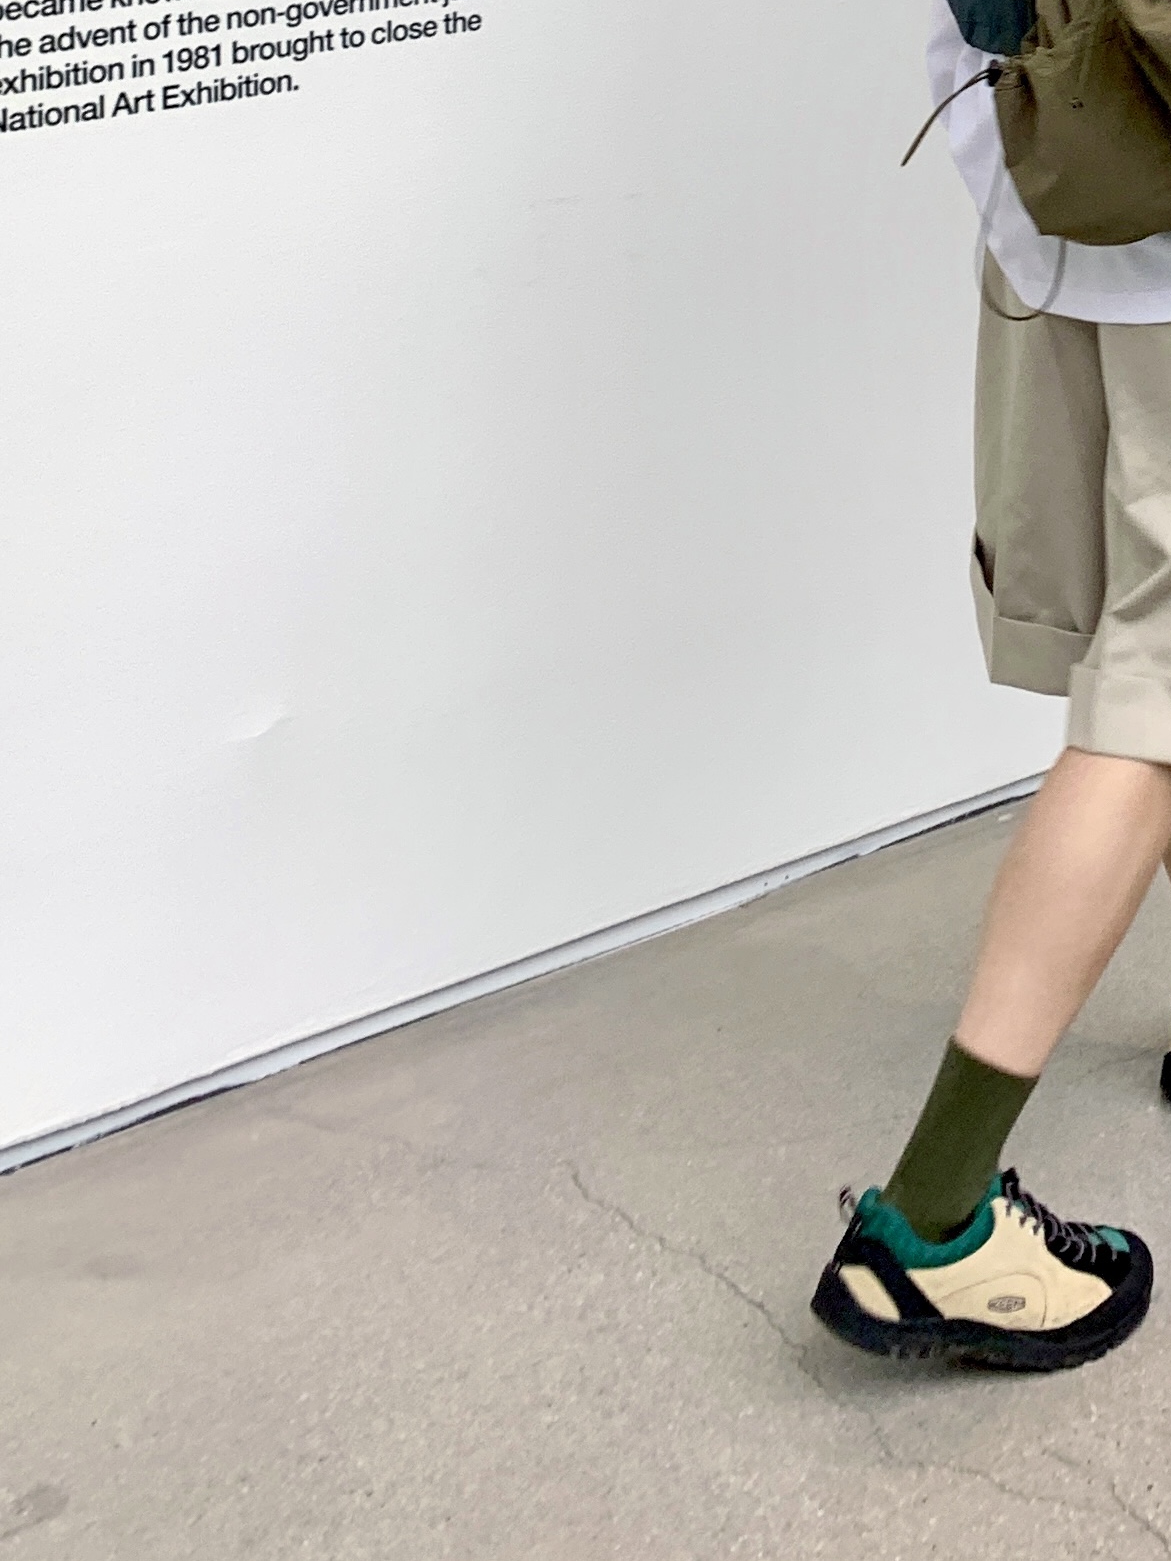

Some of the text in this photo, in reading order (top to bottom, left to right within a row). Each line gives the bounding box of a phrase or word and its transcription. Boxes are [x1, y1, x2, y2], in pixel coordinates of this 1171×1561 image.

[38, 18, 138, 55] advent
[142, 12, 173, 41] of
[175, 10, 222, 37] the
[130, 10, 483, 80] in 1981 brought to close the
[110, 72, 300, 119] Art Exhibition.
